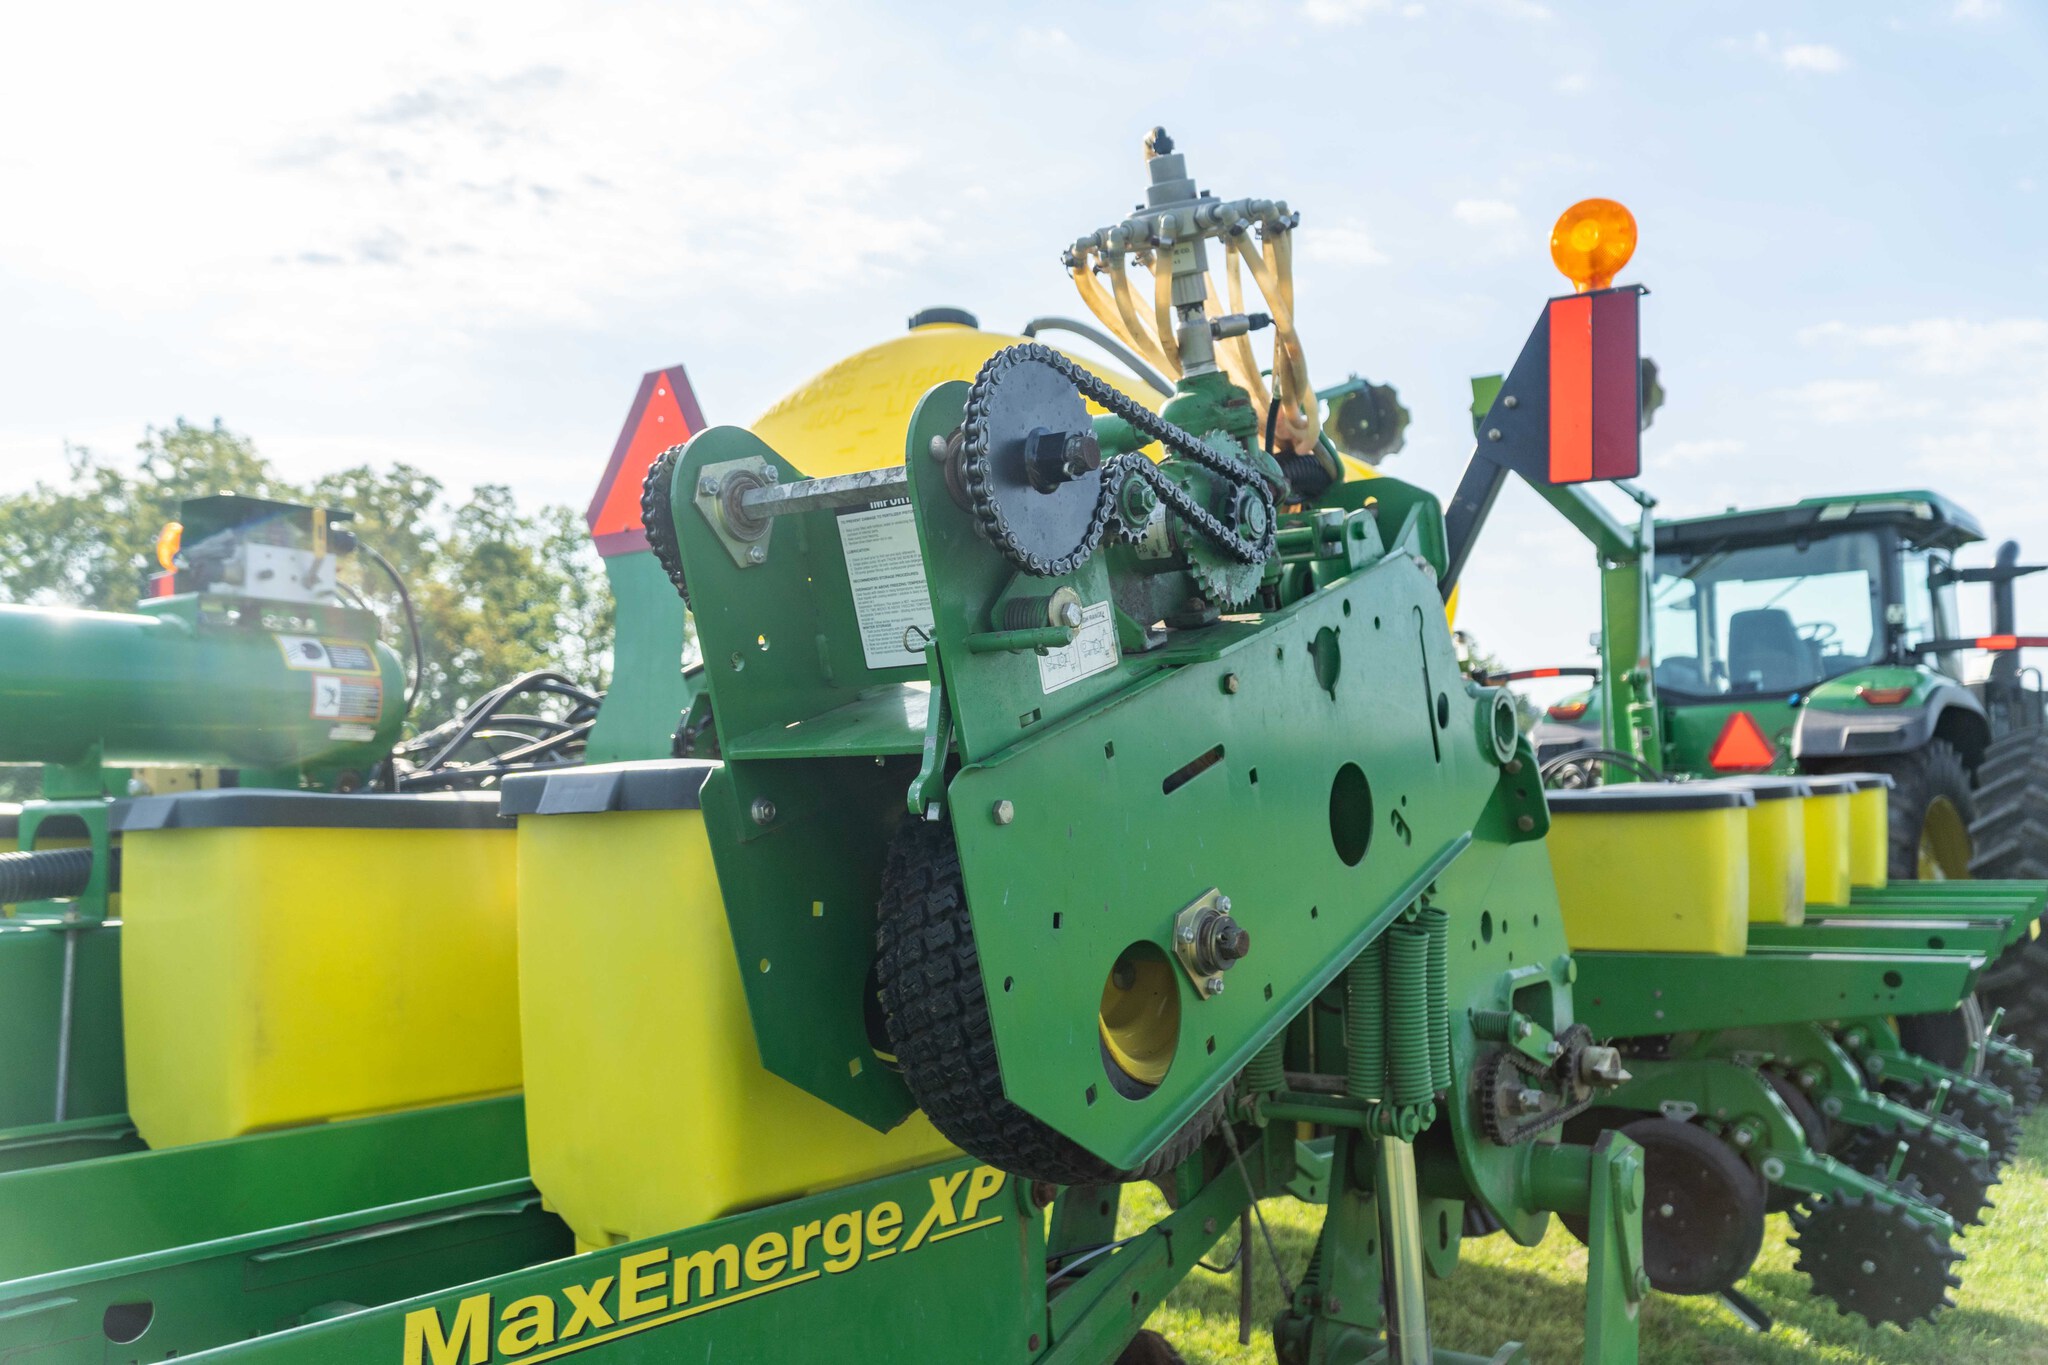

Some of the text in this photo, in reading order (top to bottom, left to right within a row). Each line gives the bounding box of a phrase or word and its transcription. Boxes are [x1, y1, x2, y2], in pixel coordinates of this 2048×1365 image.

[870, 496, 912, 510] IMPORT
[403, 1164, 1007, 1365] MaxEmerge XP
